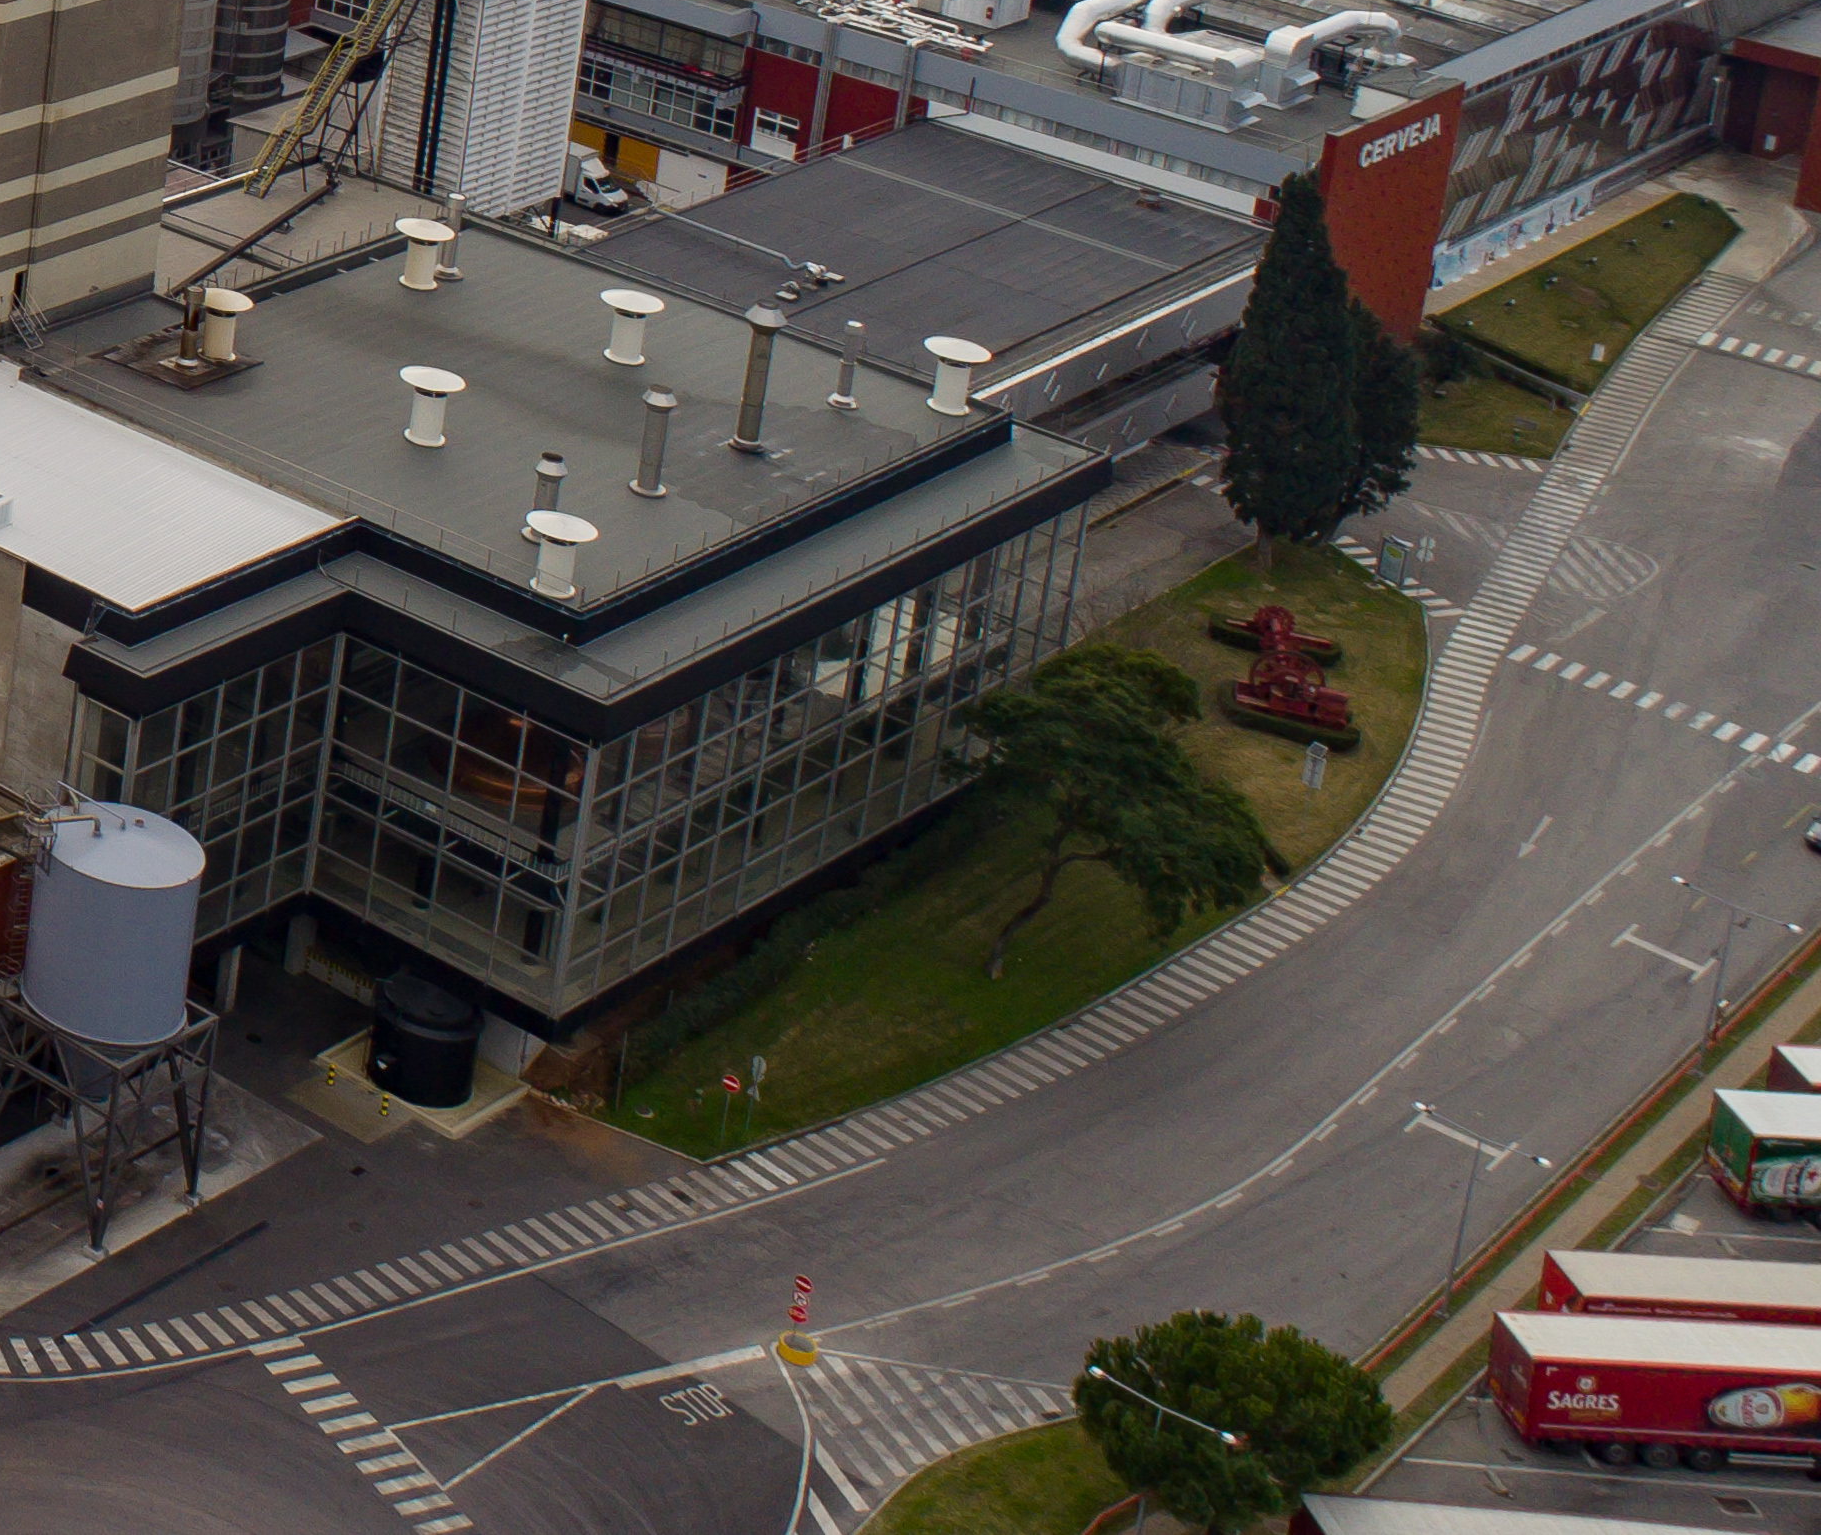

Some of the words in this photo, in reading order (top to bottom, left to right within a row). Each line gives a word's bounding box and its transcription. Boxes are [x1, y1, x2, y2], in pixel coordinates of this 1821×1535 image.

[1359, 113, 1441, 168] CERVEJA
[659, 1382, 734, 1426] STOP
[1546, 1390, 1620, 1412] SAGRES
